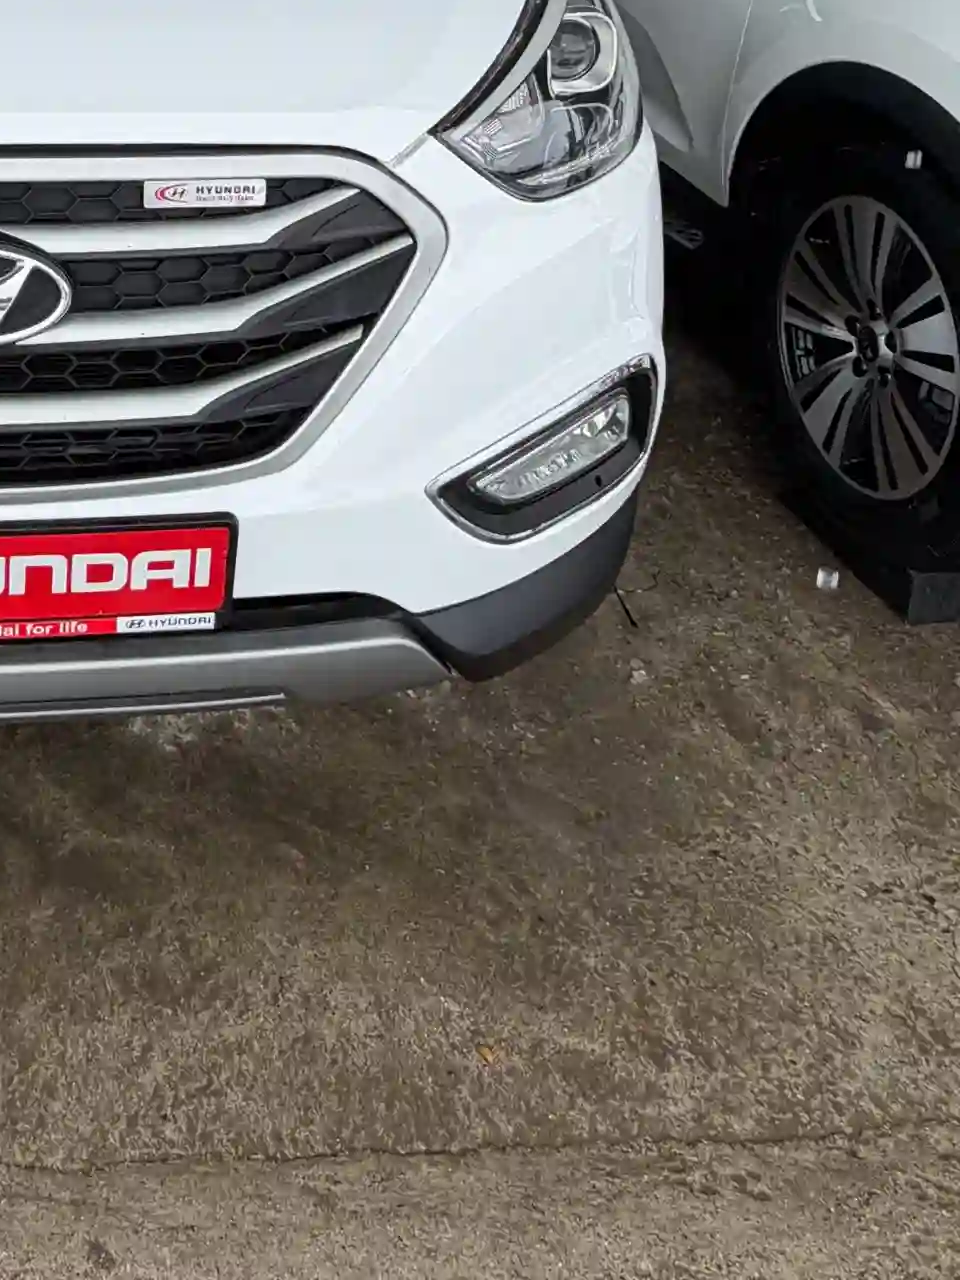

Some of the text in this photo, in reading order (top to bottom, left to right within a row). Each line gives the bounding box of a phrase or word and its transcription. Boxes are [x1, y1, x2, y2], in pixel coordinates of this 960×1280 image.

[195, 185, 256, 195] HYUNDAI
[26, 622, 53, 635] for
[59, 620, 88, 633] life
[148, 615, 212, 628] HYUNDAI
